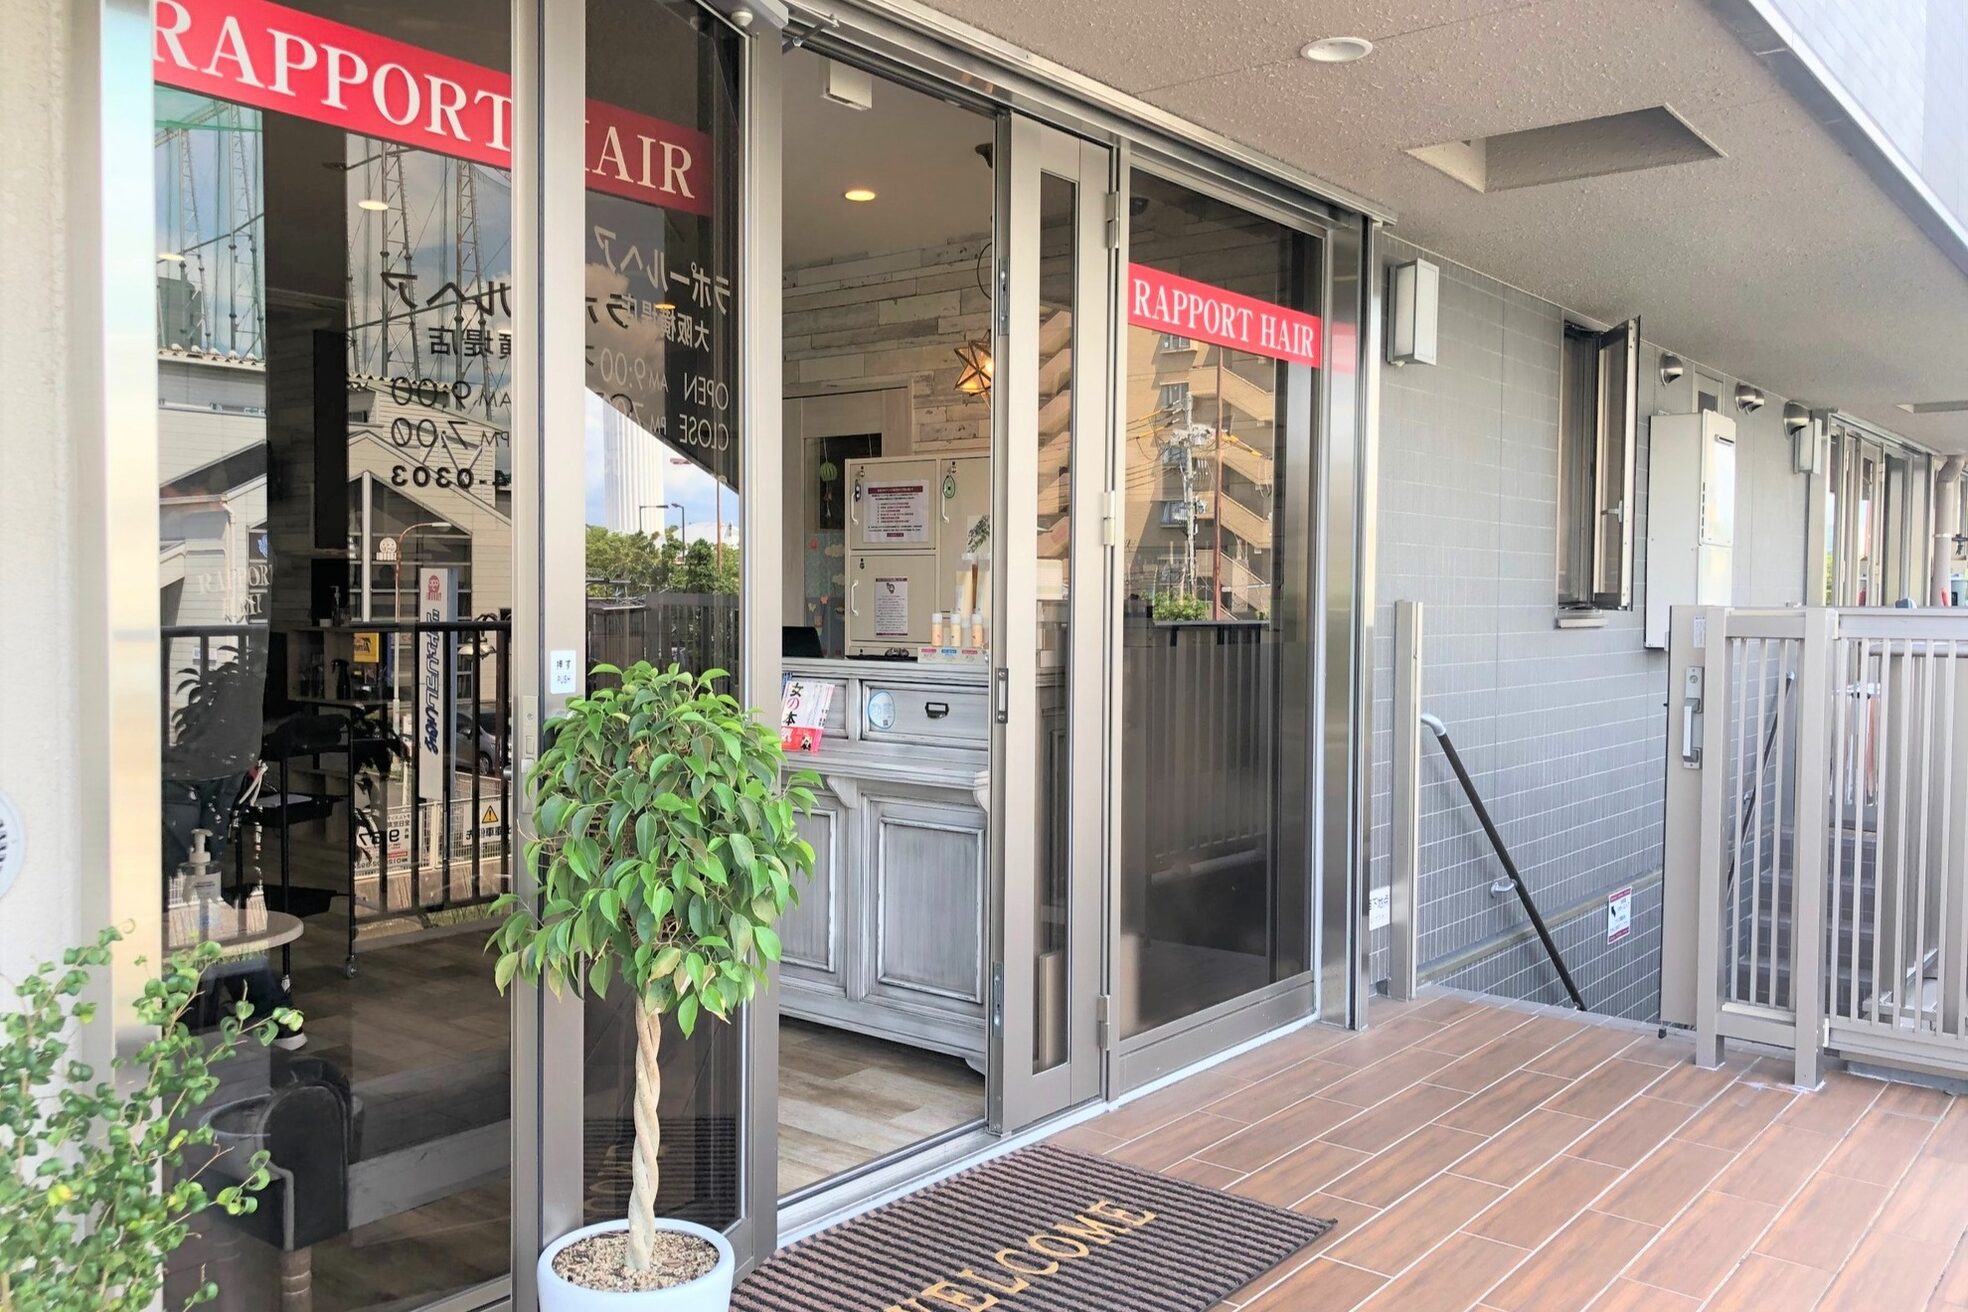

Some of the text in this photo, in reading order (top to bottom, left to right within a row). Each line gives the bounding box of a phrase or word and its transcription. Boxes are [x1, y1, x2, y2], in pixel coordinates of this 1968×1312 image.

[153, 0, 696, 199] RAPPORT AIR
[1133, 278, 1314, 358] RAPPORT HAIR
